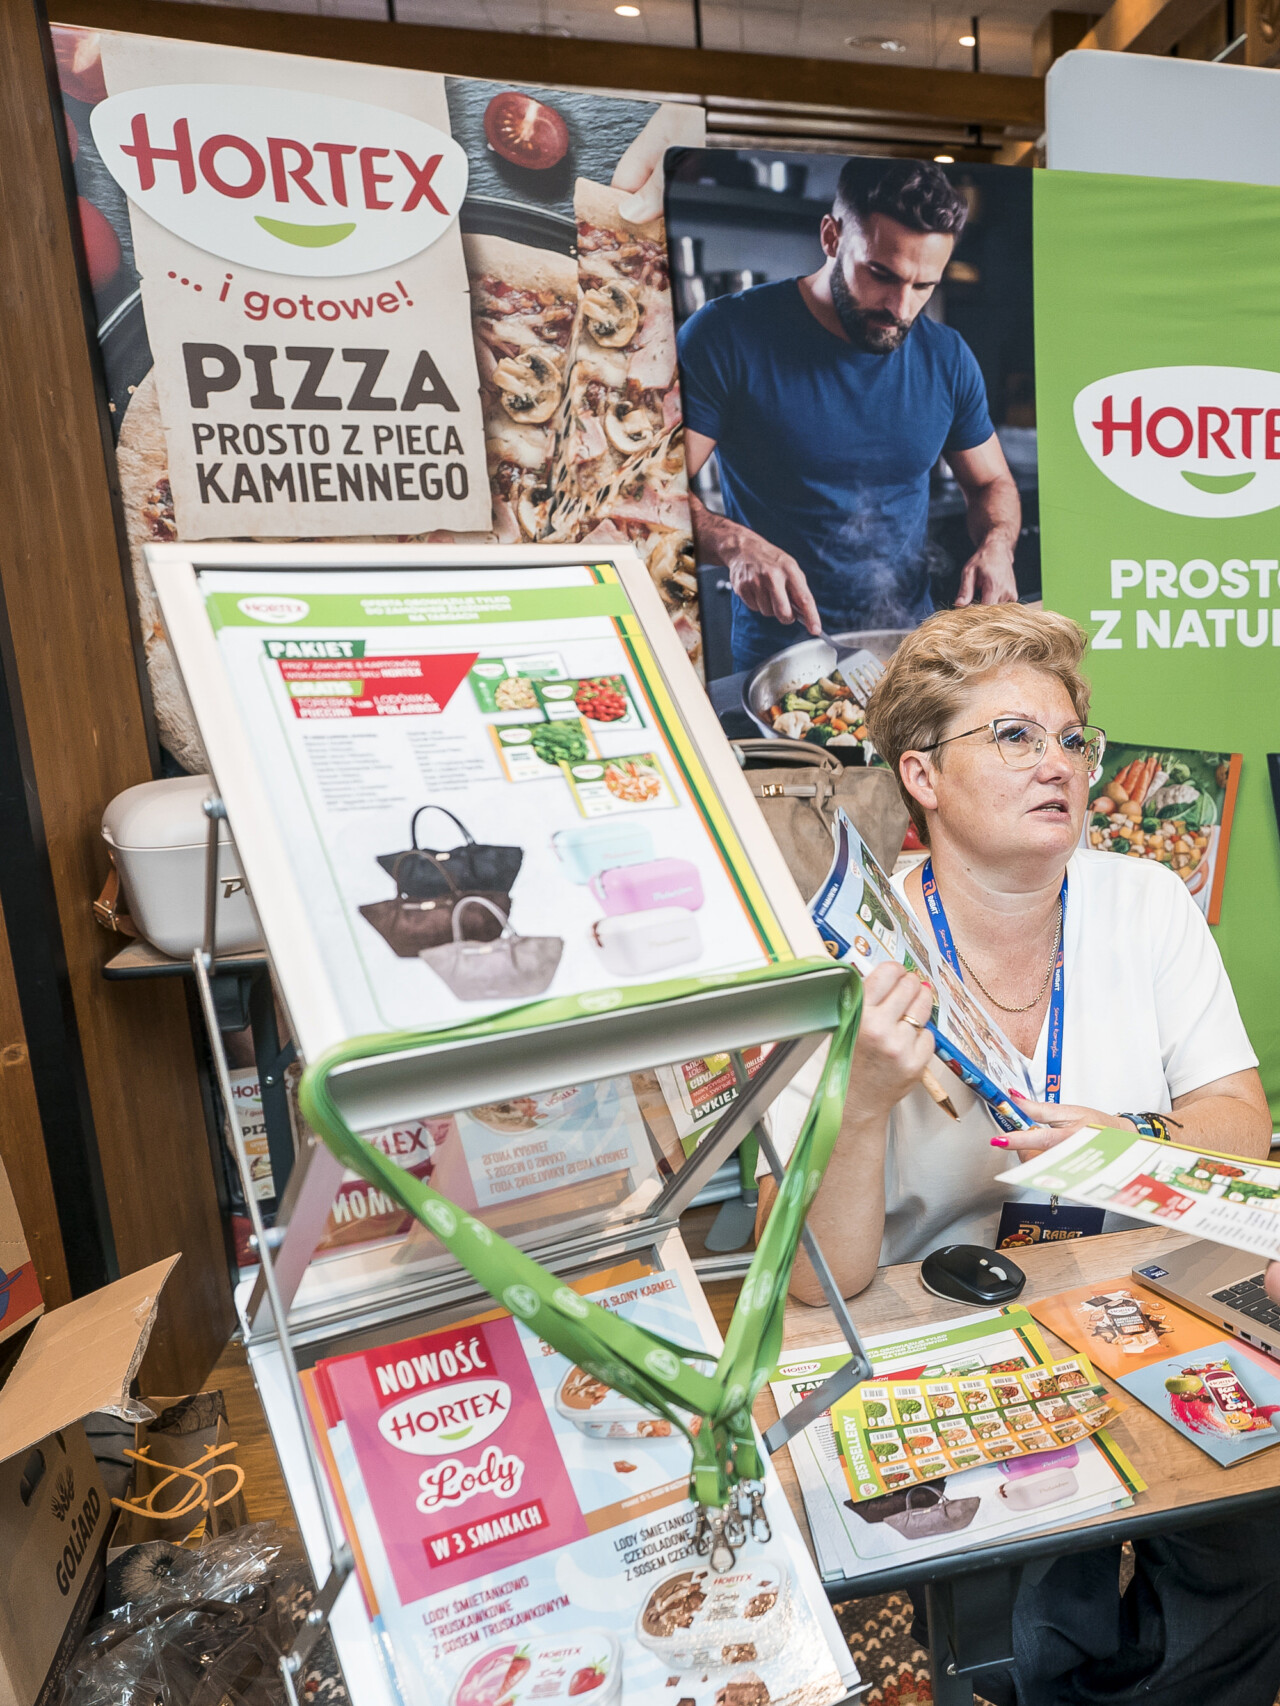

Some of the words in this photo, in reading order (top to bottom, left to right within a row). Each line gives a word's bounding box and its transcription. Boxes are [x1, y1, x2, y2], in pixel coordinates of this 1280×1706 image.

[120, 113, 450, 216] HORTEX
[219, 273, 235, 303] i
[244, 280, 415, 322] gotowe!
[182, 342, 460, 412] PIZZA
[193, 423, 329, 456] PROSTO
[342, 425, 364, 456] Z
[375, 424, 465, 456] PIECA
[199, 462, 469, 504] KAMIENNEGO
[268, 641, 354, 658] PAKIET
[1091, 610, 1122, 650] Z
[290, 682, 354, 695] GRATIS
[926, 894, 939, 916] RABAT
[1043, 1229, 1084, 1240] RABAT
[610, 1289, 639, 1308] SŁONY
[641, 1279, 677, 1297] KARMEL
[375, 1337, 487, 1396] NOWOŚĆ
[782, 1364, 818, 1375] HORTEX
[390, 1389, 506, 1441] HORTEX
[843, 1415, 870, 1480] BESTSELLERY
[424, 1452, 518, 1506] Lody
[430, 1537, 450, 1560] W
[452, 1532, 466, 1553] 3
[467, 1505, 542, 1548] SMAKACH
[613, 1534, 638, 1552] LODY
[640, 1511, 696, 1541] ŚMIETANKO
[625, 1570, 632, 1582] Z
[633, 1559, 666, 1578] SOSEM
[422, 1606, 449, 1626] LODY
[452, 1575, 530, 1614] ŚMIETANKOWO
[433, 1644, 440, 1659] Z
[442, 1633, 480, 1655] SOSEM
[483, 1594, 571, 1638] TRUSKAWKOWYM
